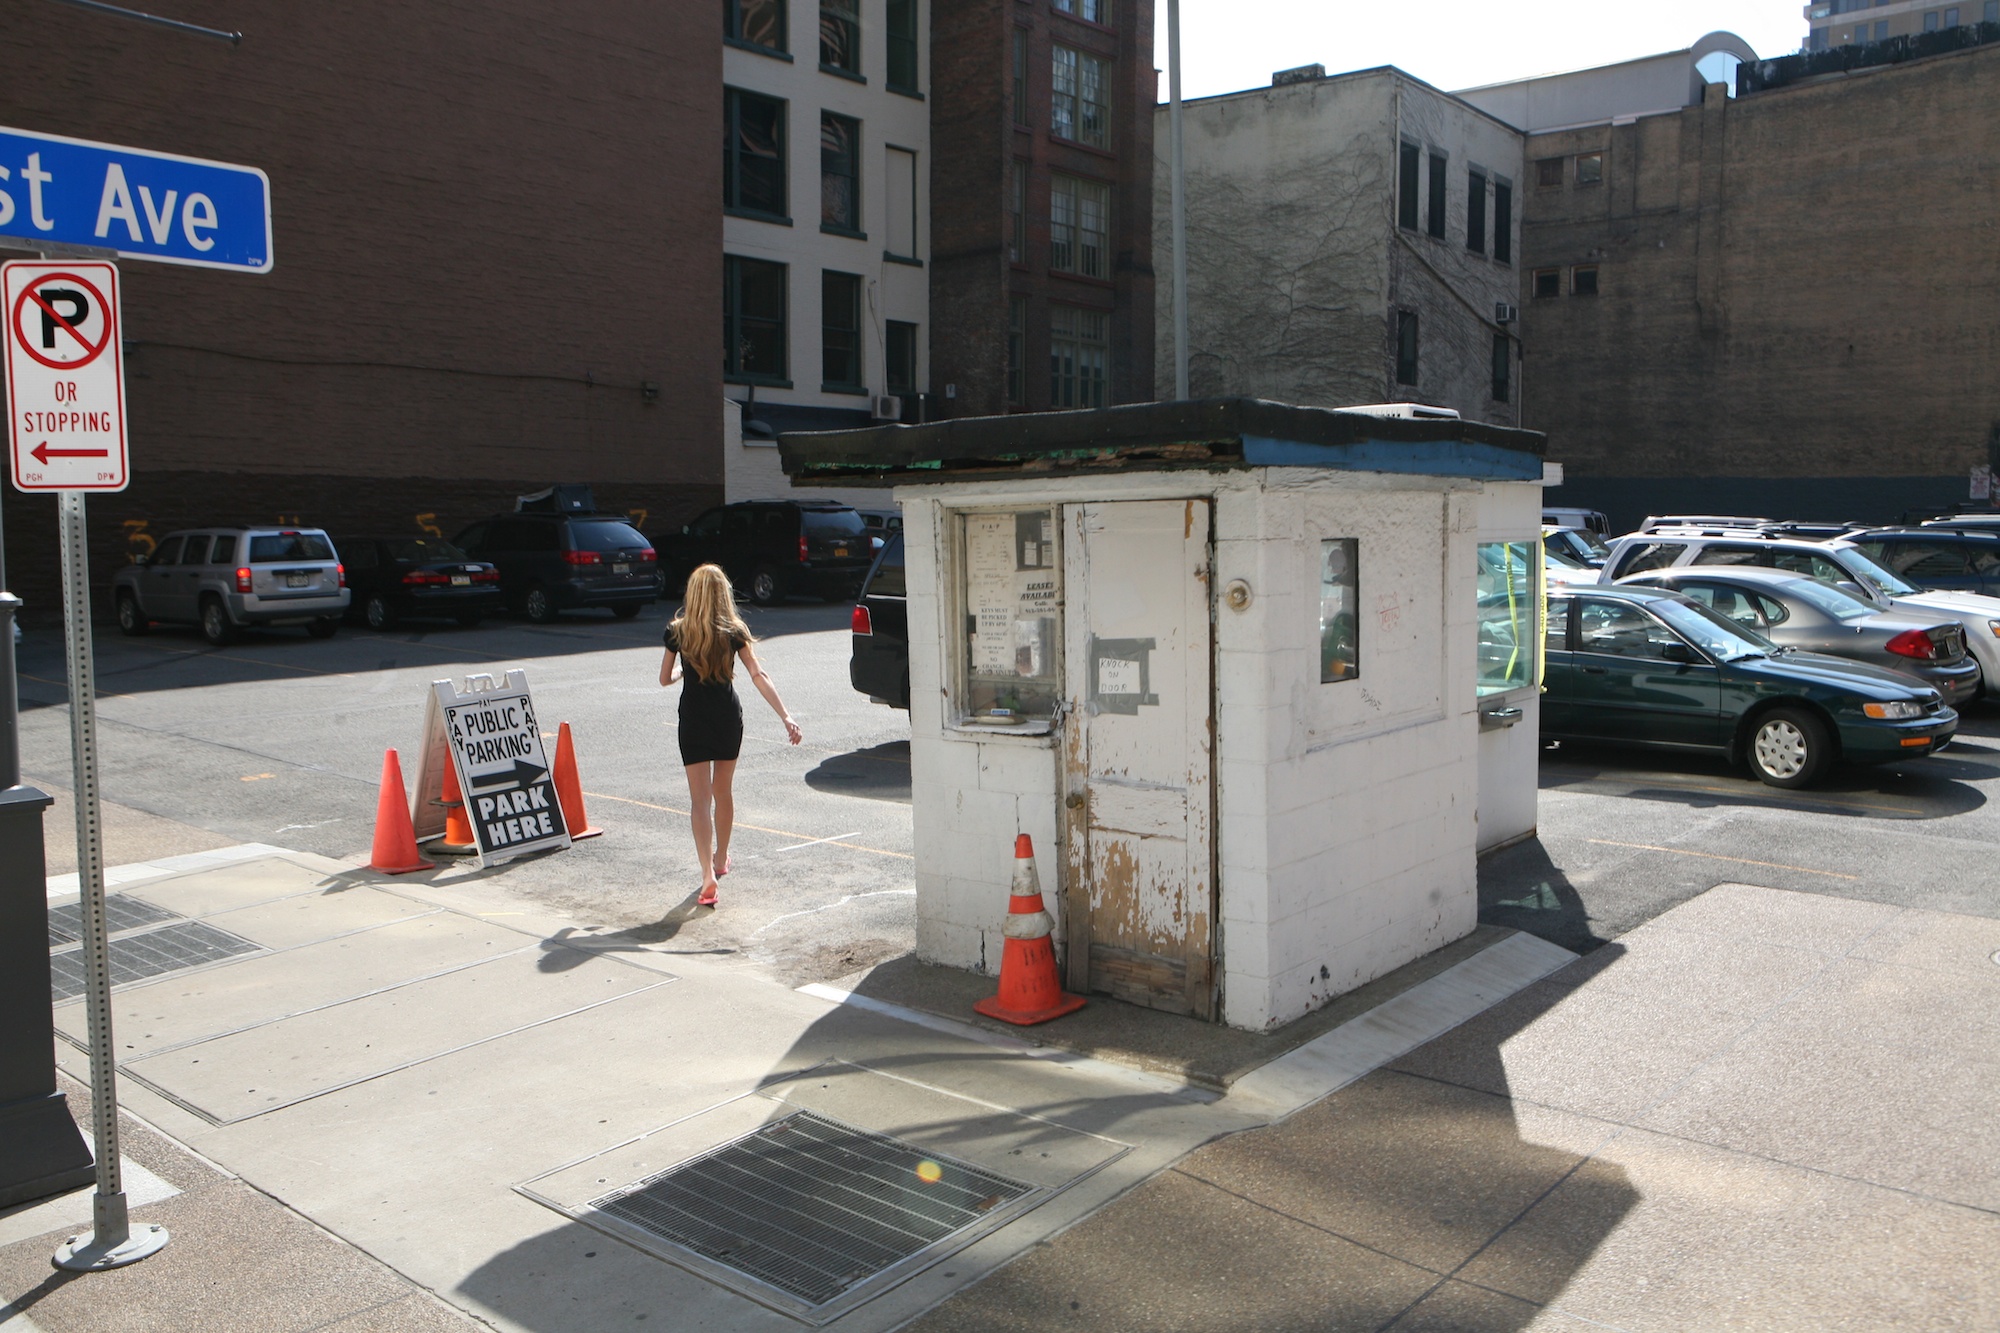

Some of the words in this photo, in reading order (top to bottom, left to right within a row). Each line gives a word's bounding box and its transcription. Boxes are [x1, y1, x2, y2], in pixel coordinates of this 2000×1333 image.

[94, 162, 219, 252] Ave
[55, 381, 77, 402] OR
[24, 411, 111, 433] STOPPING
[26, 473, 43, 482] PGH
[97, 472, 115, 481] DPW
[1100, 659, 1130, 669] KNOCK
[1101, 683, 1127, 693] DOOR
[464, 706, 519, 737] PUBLIC
[465, 733, 532, 766] PARKING
[477, 785, 550, 821] PARK
[487, 811, 554, 847] HERE
